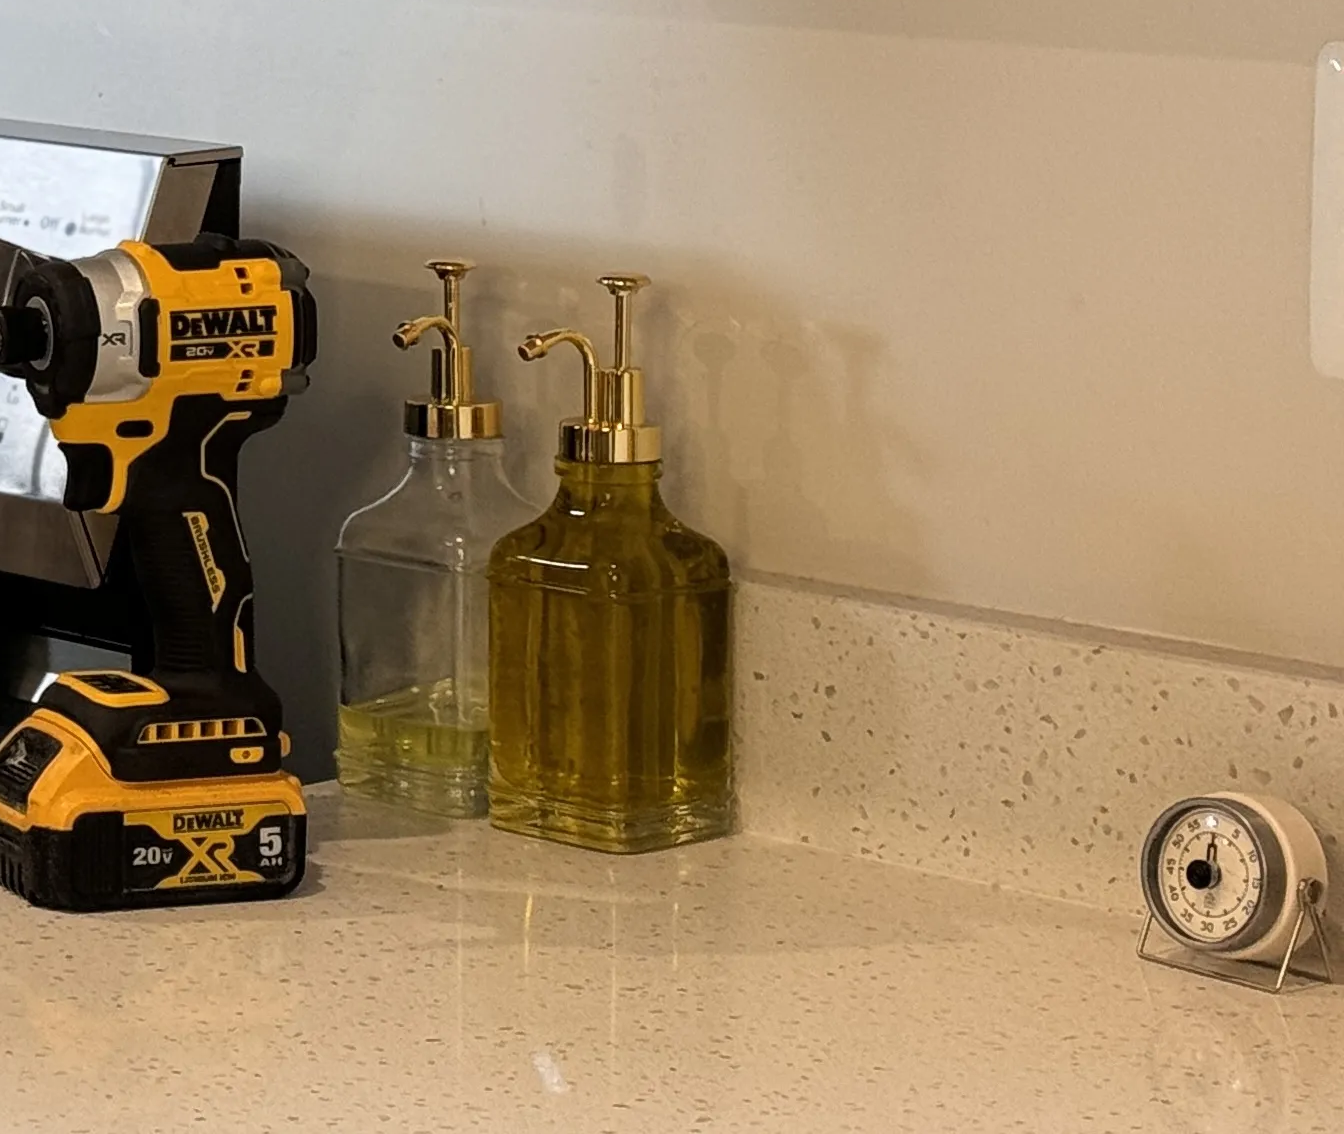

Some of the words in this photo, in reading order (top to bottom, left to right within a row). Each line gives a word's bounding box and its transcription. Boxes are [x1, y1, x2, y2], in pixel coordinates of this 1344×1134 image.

[101, 332, 127, 347] XR
[226, 341, 261, 360] XR
[259, 826, 283, 857] 5
[1172, 833, 1185, 849] 50
[1231, 828, 1241, 840] 5
[178, 834, 239, 874] XR
[1242, 899, 1255, 916] 20
[1180, 908, 1195, 923] 35
[1200, 920, 1214, 933] 30
[1223, 917, 1238, 931] 25
